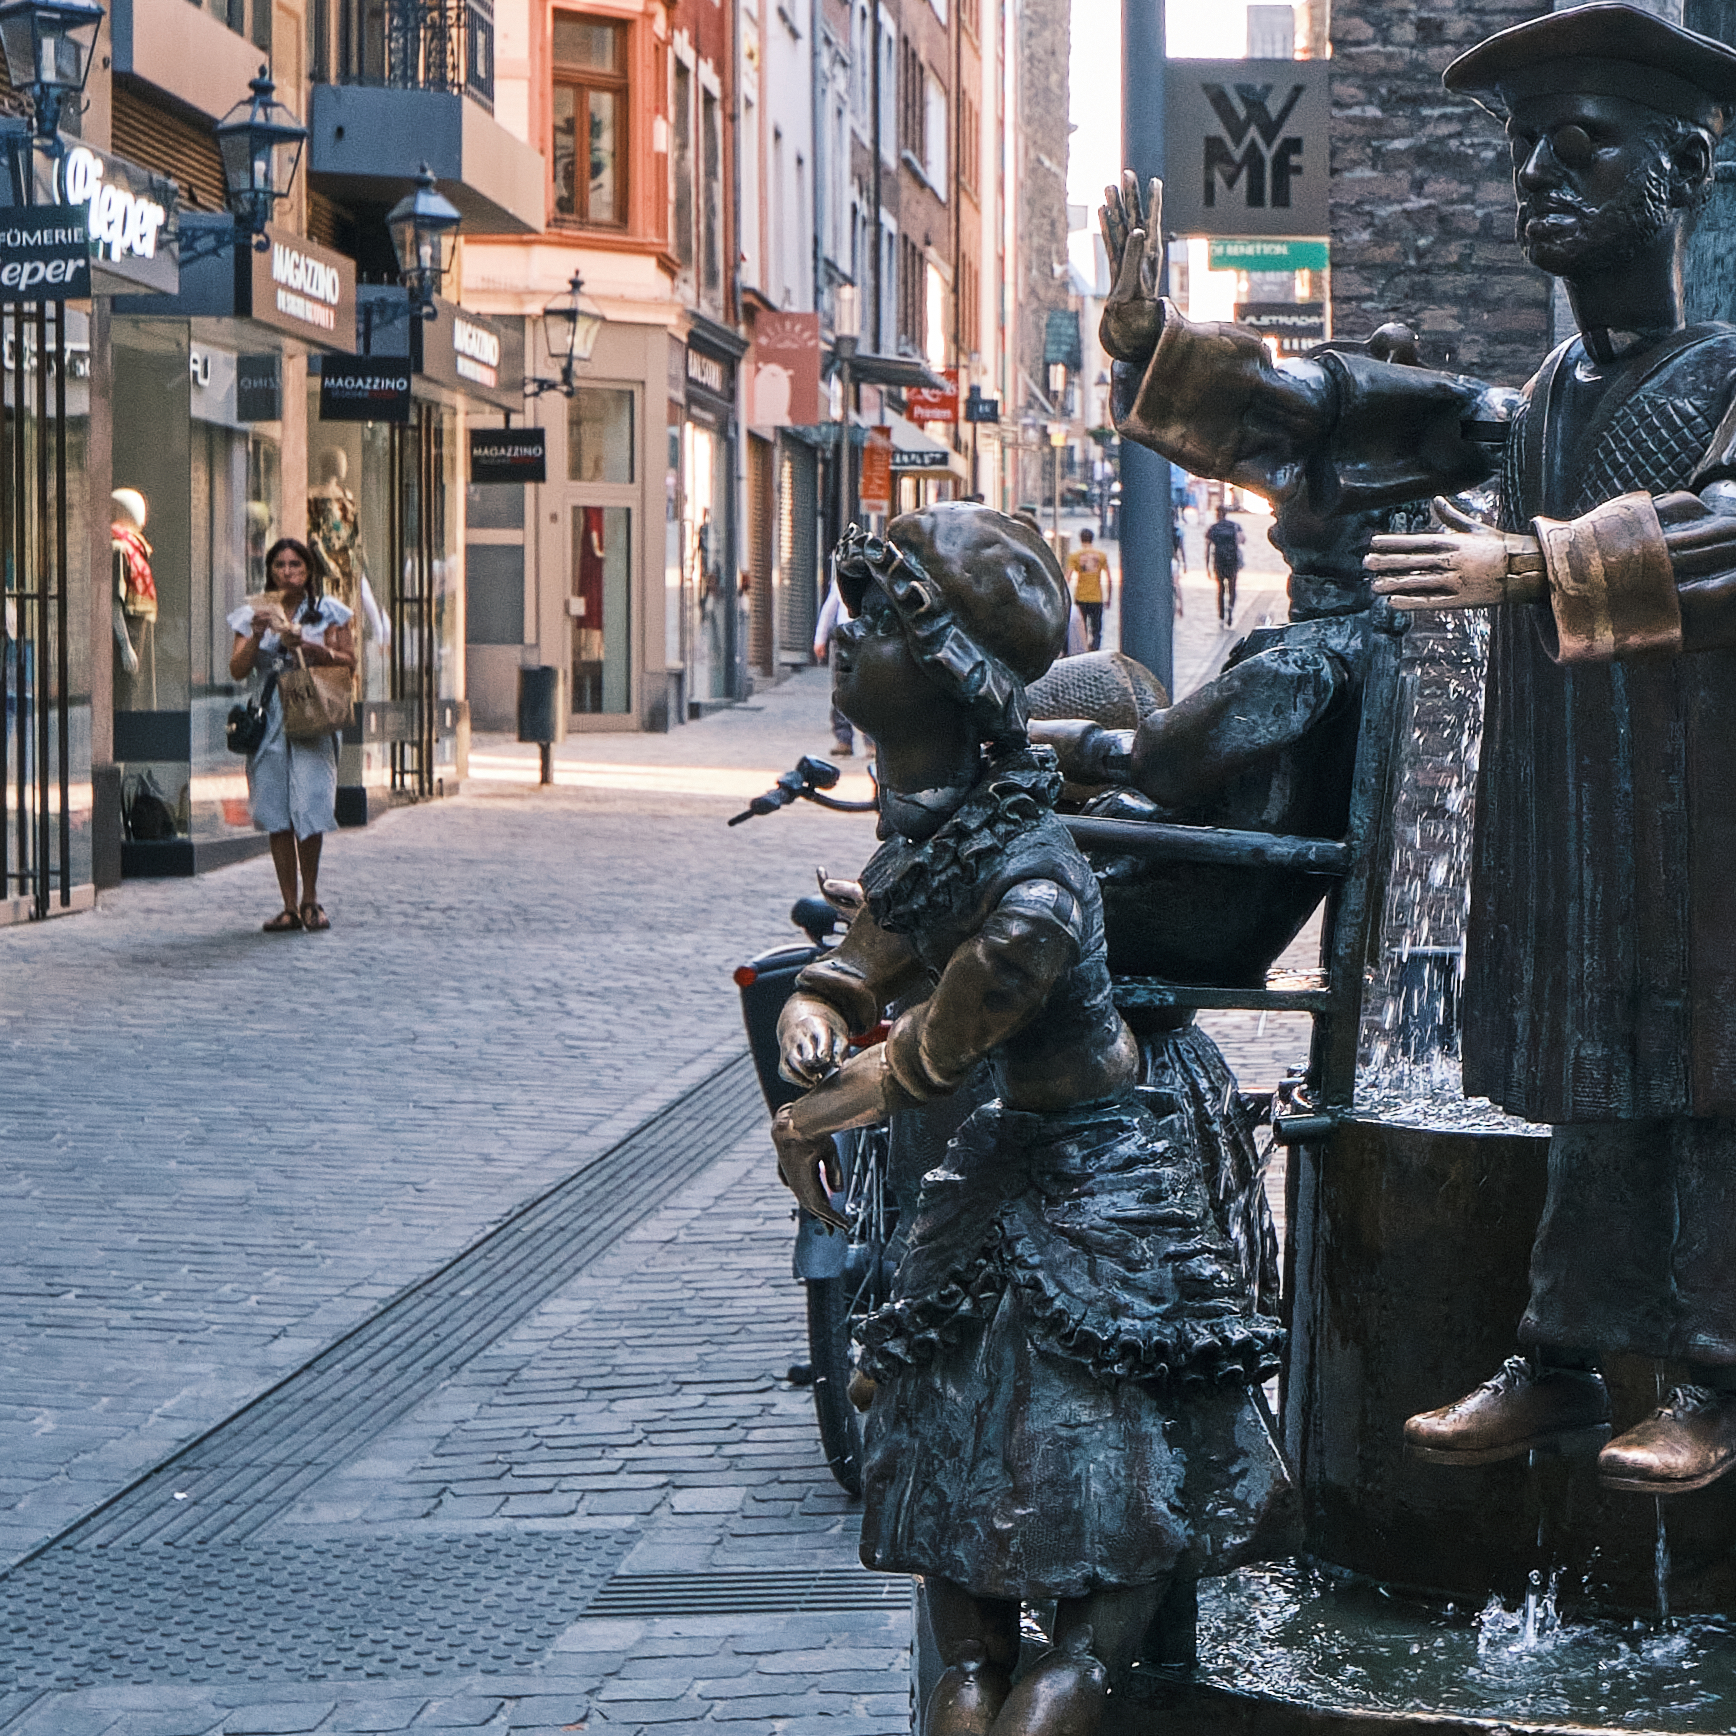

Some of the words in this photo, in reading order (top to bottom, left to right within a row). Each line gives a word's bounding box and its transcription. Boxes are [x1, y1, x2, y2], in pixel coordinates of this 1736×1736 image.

[1201, 83, 1306, 207] WMF
[66, 147, 166, 263] Pieper
[0, 227, 85, 249] ÜMERIE
[1, 258, 86, 292] eper
[272, 241, 340, 306] MAGAZZINO
[323, 375, 409, 392] MAGAZZINO
[472, 444, 544, 458] MAGAZZINO
